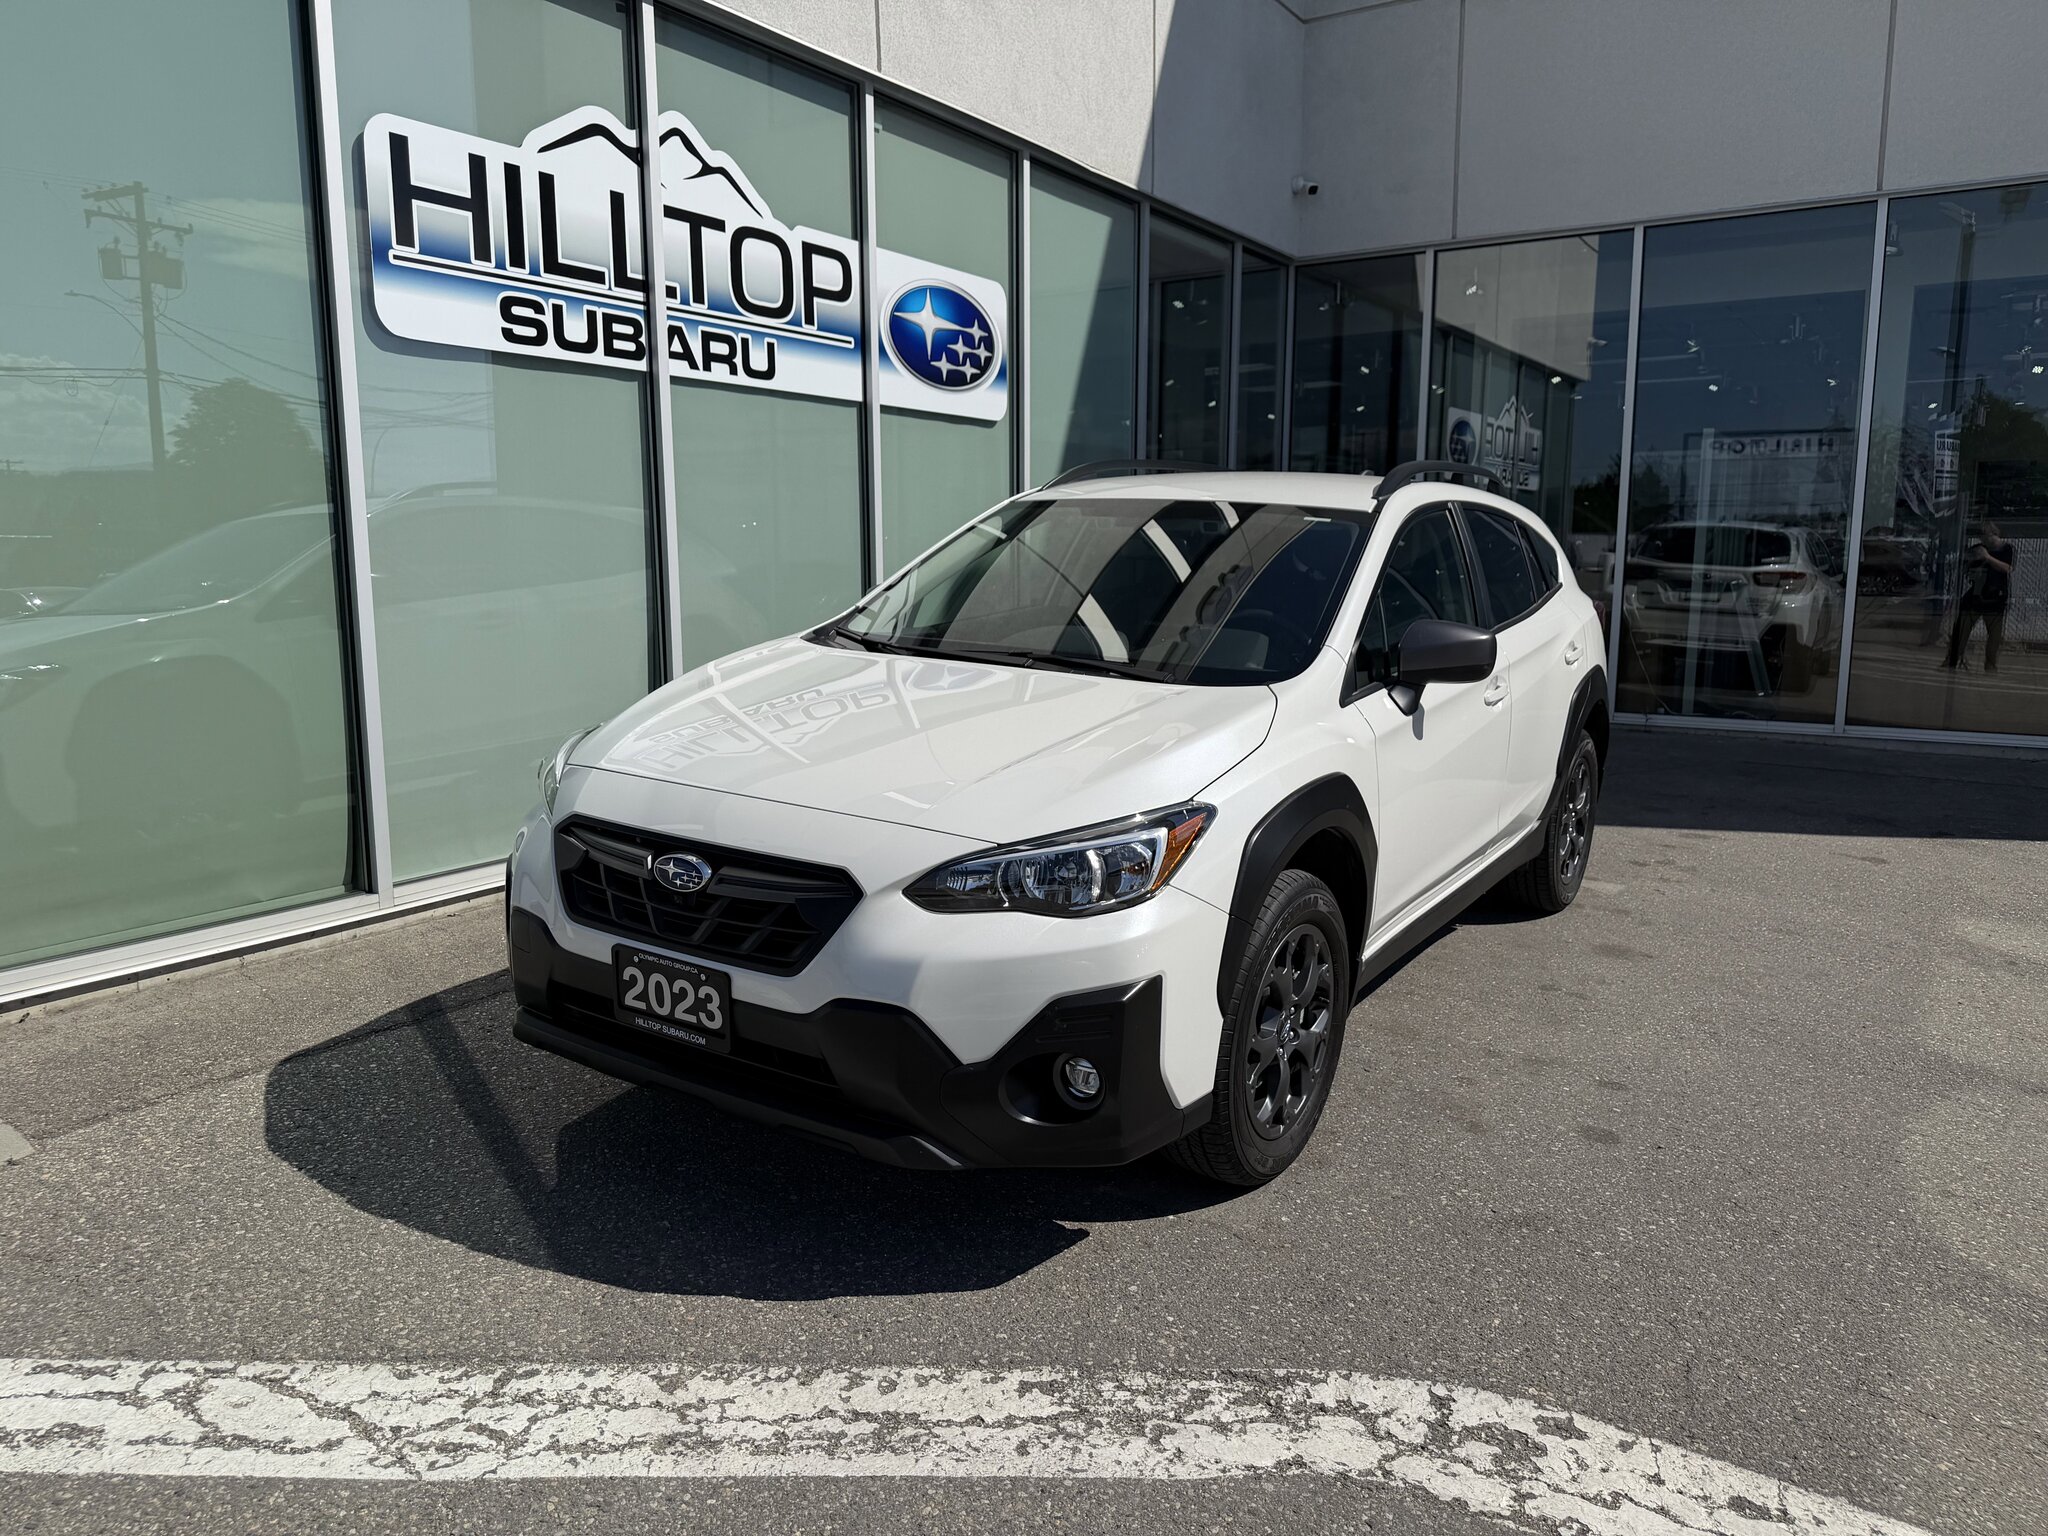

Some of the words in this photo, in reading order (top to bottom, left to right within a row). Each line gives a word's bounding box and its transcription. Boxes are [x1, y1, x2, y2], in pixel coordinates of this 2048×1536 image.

[389, 131, 853, 327] HILLTOP
[501, 295, 776, 381] SUBARU
[638, 952, 659, 964] OLYMPIC
[659, 958, 673, 967] AUTO
[622, 966, 723, 1030] 2023
[635, 1016, 661, 1032] HILLTOP
[662, 1025, 706, 1045] SUBARU.COM
